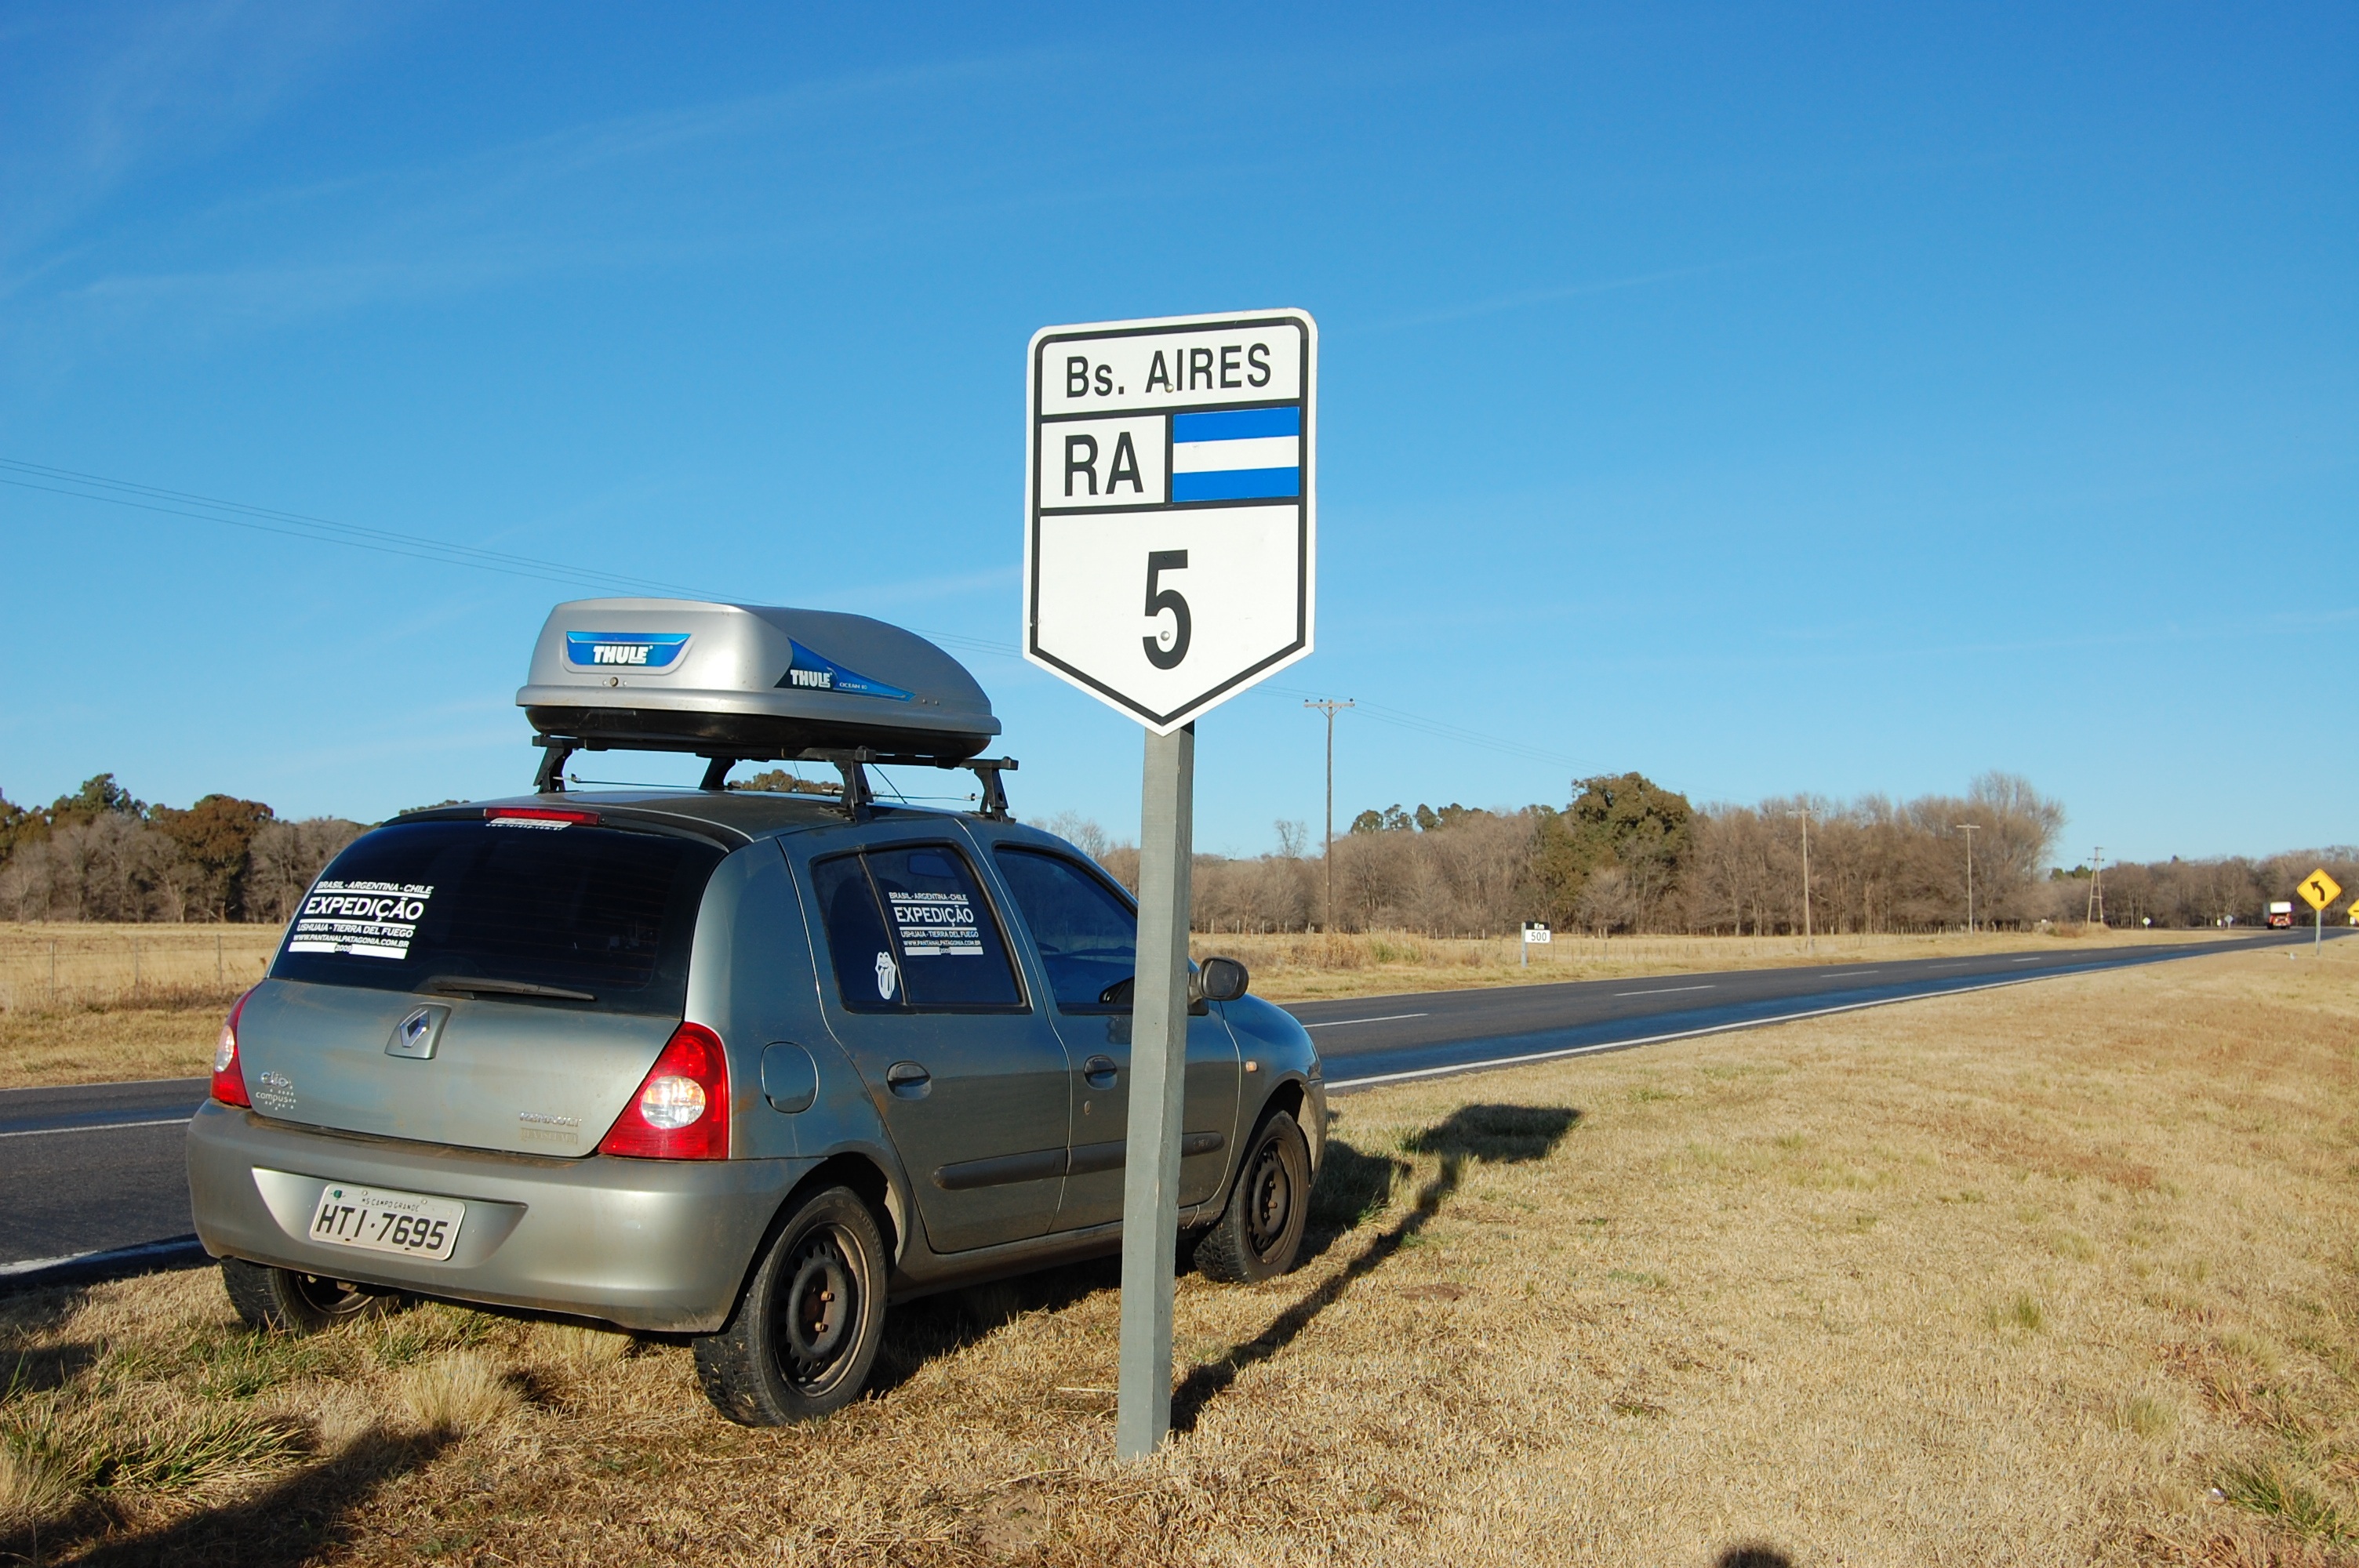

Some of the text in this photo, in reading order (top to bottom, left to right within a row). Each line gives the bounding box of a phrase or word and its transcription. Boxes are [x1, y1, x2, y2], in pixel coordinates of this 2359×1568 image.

[1067, 343, 1272, 398] Bs. AIRES
[1064, 431, 1144, 497] RA
[1143, 549, 1192, 670] 5
[593, 645, 649, 664] THULE
[790, 669, 831, 688] THULE
[316, 880, 434, 895] BRASIL ARGENTINA CHILE
[304, 896, 424, 922] EXPEDIÇÃO
[893, 904, 974, 927] EXPEDIÇÃO
[296, 923, 414, 938] USHUAIA TIERRA DEL FUEGO
[1531, 931, 1547, 942] 500
[256, 1091, 289, 1104] campus
[371, 1199, 393, 1208] CAMPO
[394, 1202, 420, 1212] GRANDE
